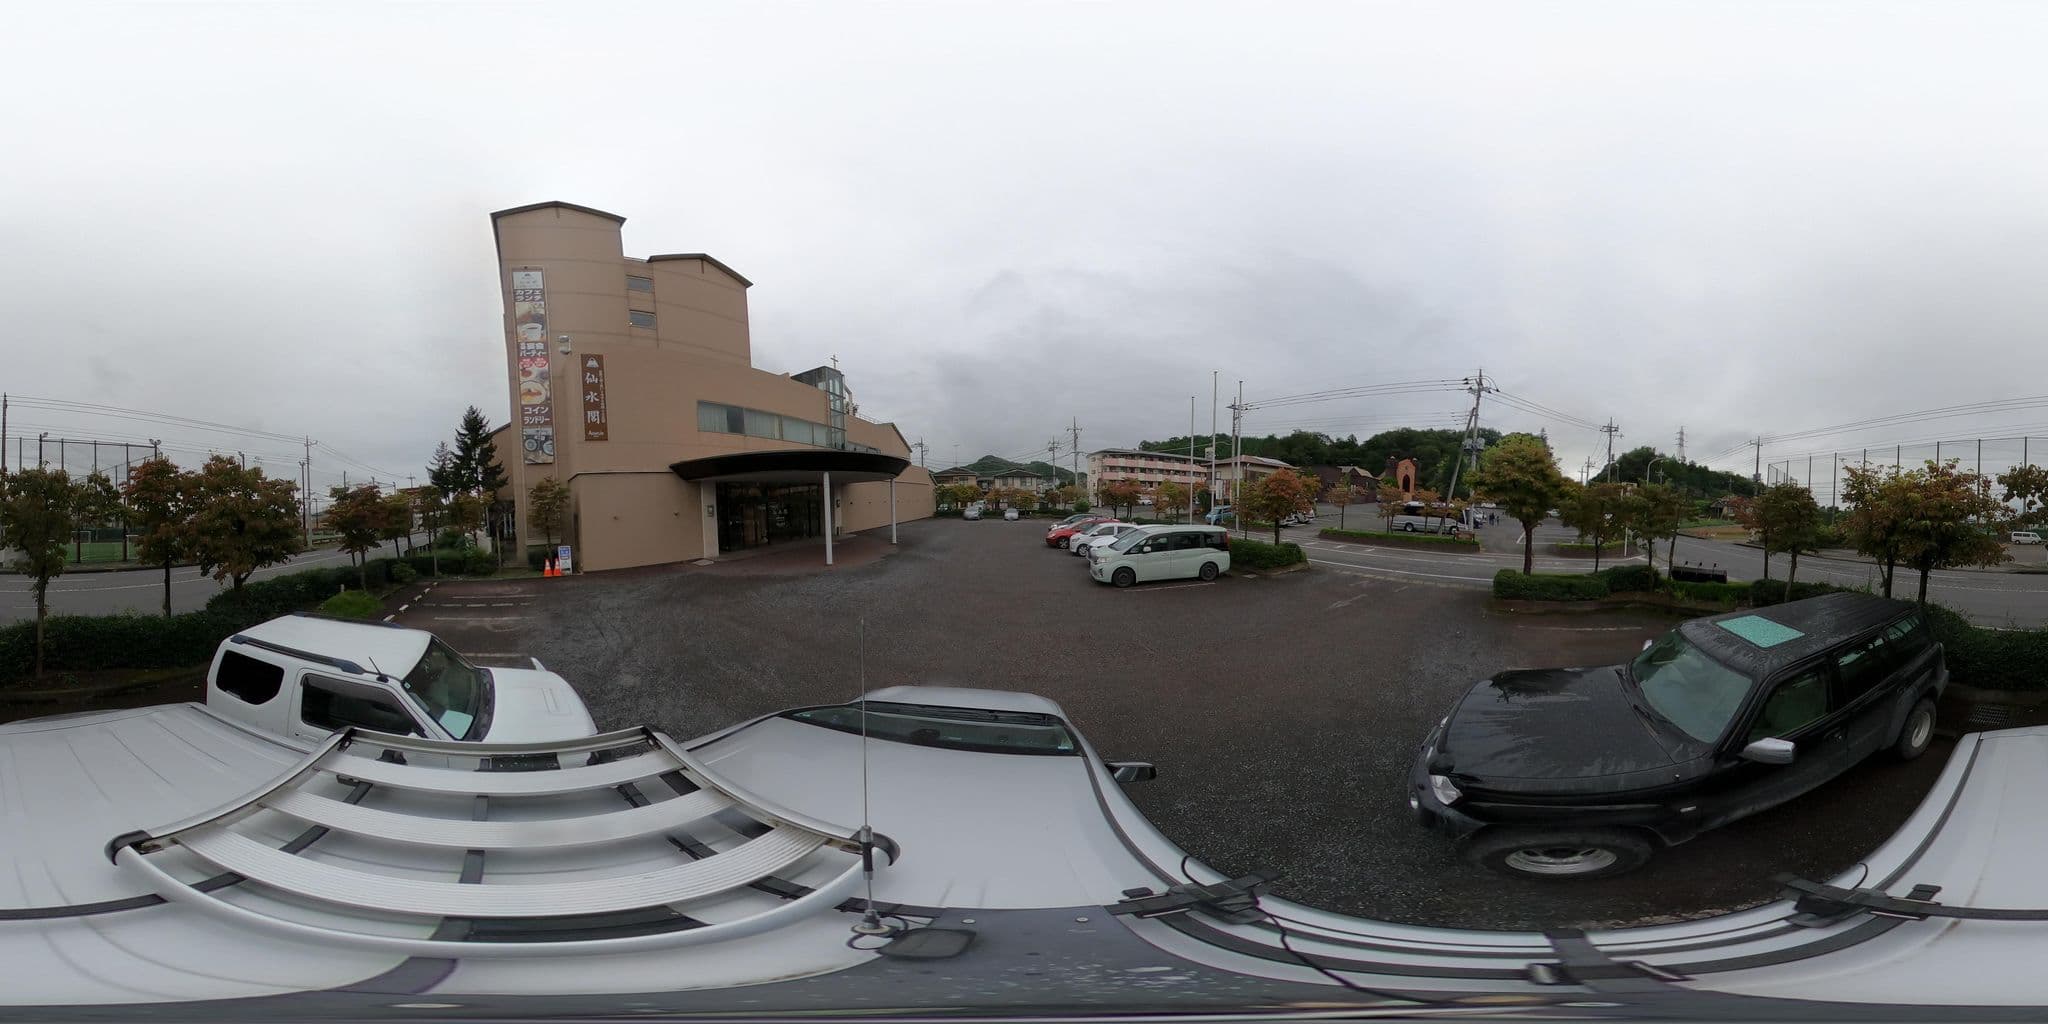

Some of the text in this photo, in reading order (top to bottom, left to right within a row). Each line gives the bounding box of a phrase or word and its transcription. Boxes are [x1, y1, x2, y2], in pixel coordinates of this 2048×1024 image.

[524, 406, 548, 414] コイン
[524, 415, 550, 424] ランドリー
